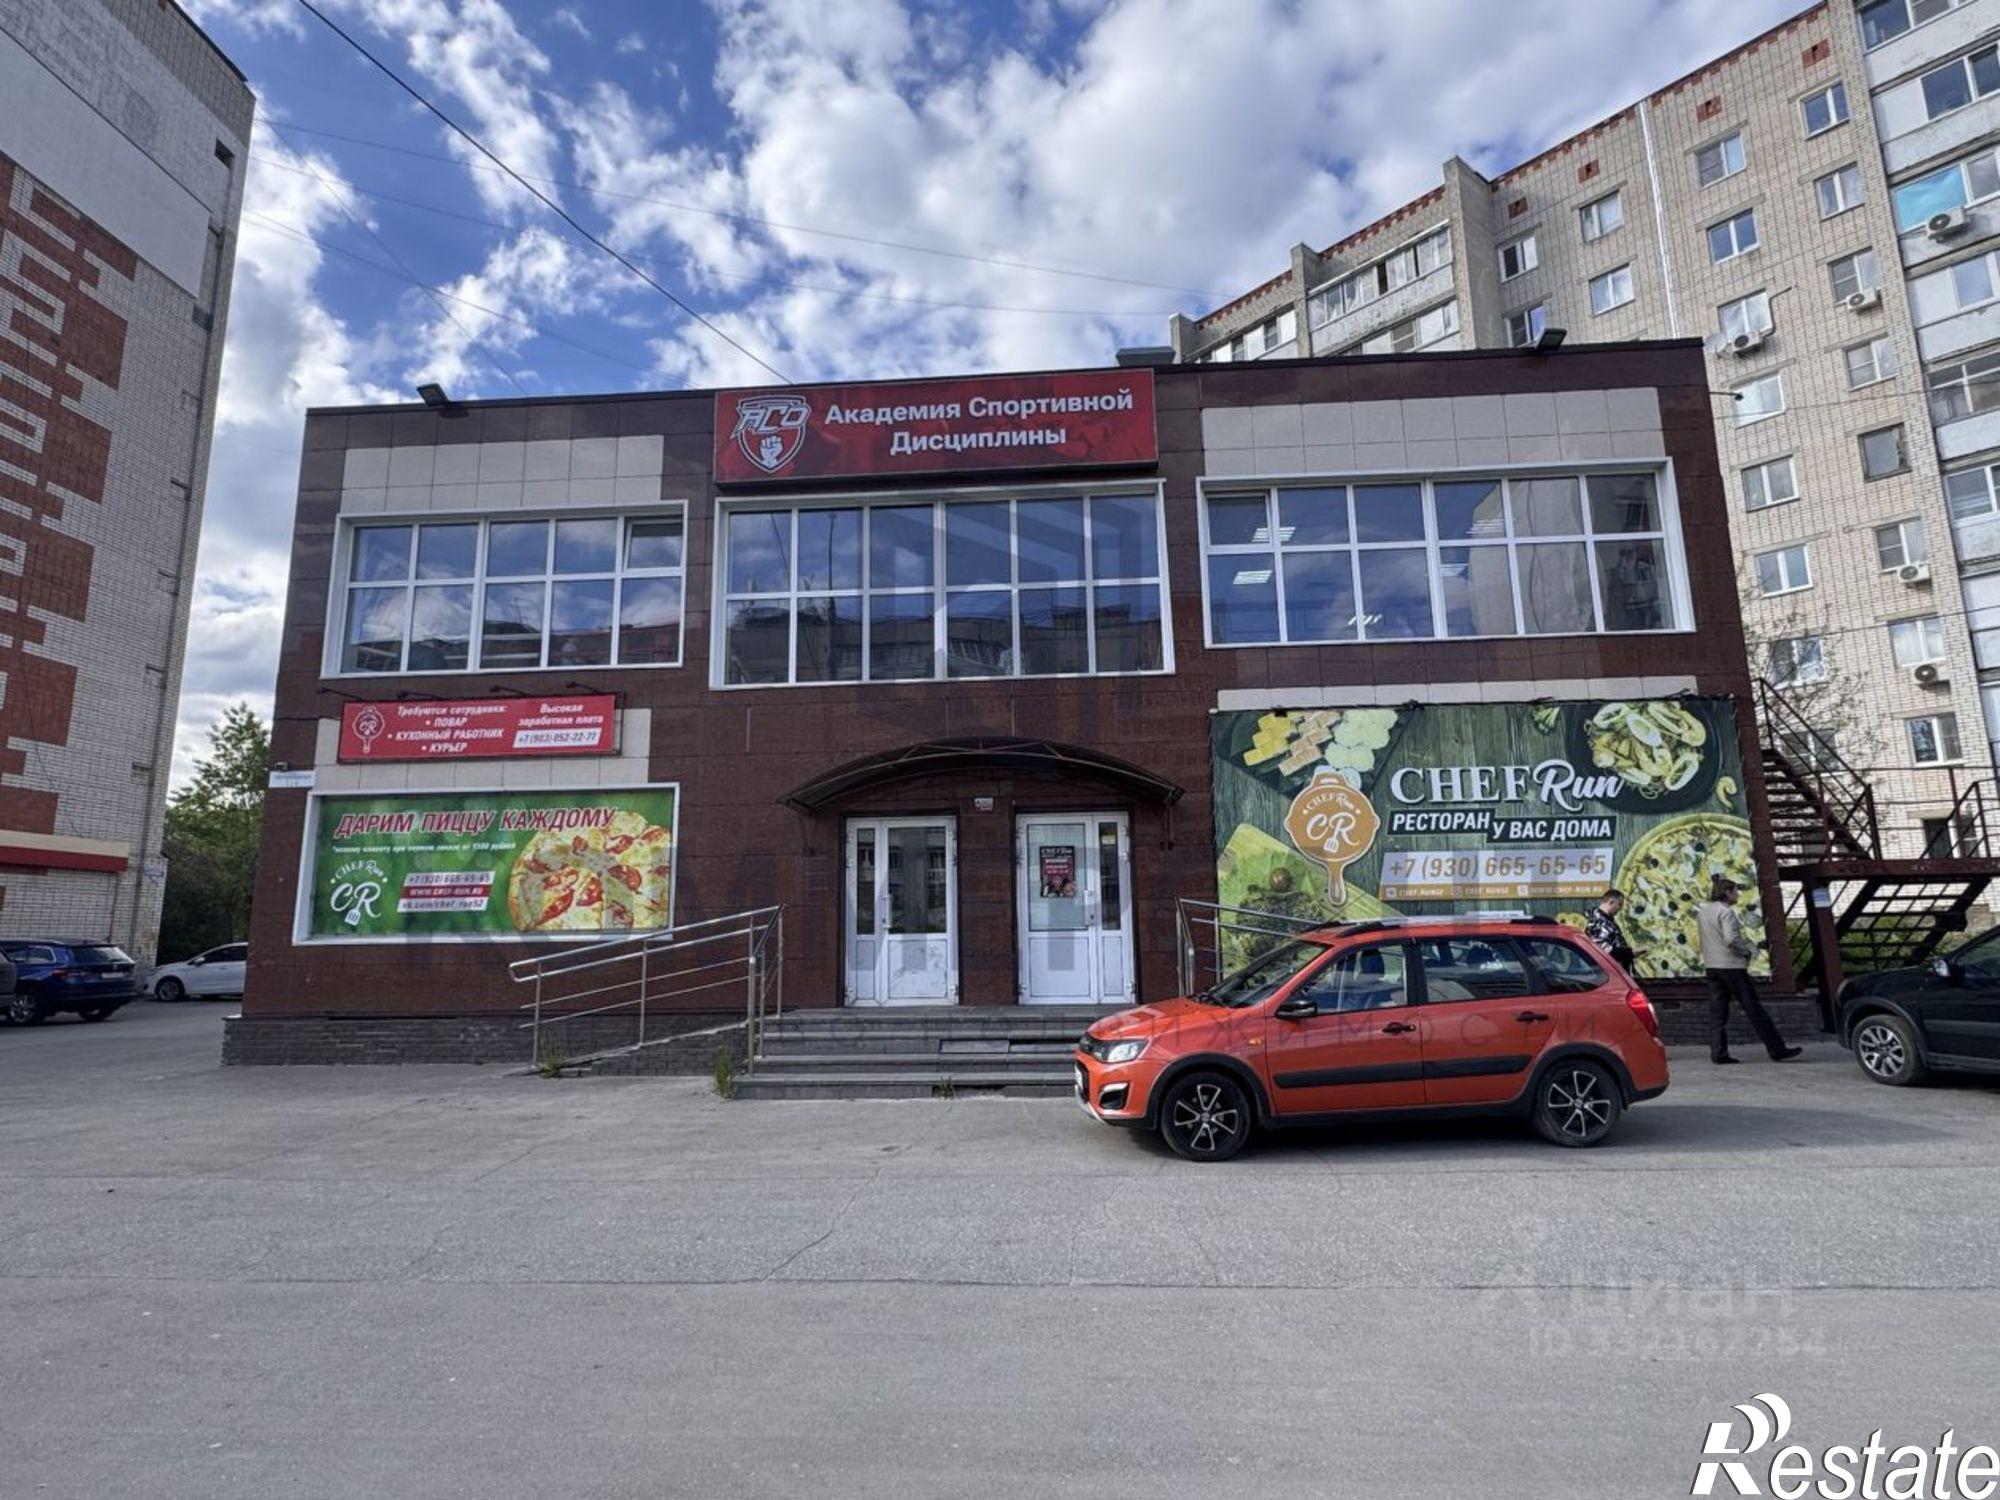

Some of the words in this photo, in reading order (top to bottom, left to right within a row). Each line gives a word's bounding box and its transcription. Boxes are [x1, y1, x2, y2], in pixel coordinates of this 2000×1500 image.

[825, 402, 961, 425] Академия
[969, 388, 1134, 417] Спортивной
[890, 427, 1067, 455] Дисциплины
[395, 729, 451, 741] КУХОННЫЙ
[434, 717, 468, 727] ПОВАР
[429, 742, 468, 753] КУРЬЕР
[1389, 766, 1533, 805] CHEF
[1534, 758, 1626, 811] Run
[334, 811, 414, 837] ДАРИМ
[421, 808, 496, 837] ПИЦЦУ
[500, 806, 615, 833] КАЖДОМУ
[1392, 811, 1489, 833] РЕСТОРАН
[1509, 819, 1547, 840] ВАС
[1551, 818, 1613, 842] ДОМА
[1389, 858, 1415, 879] +7
[1421, 854, 1479, 879] (930)
[1484, 853, 1606, 877] 665-65-65
[330, 882, 383, 918] CR
